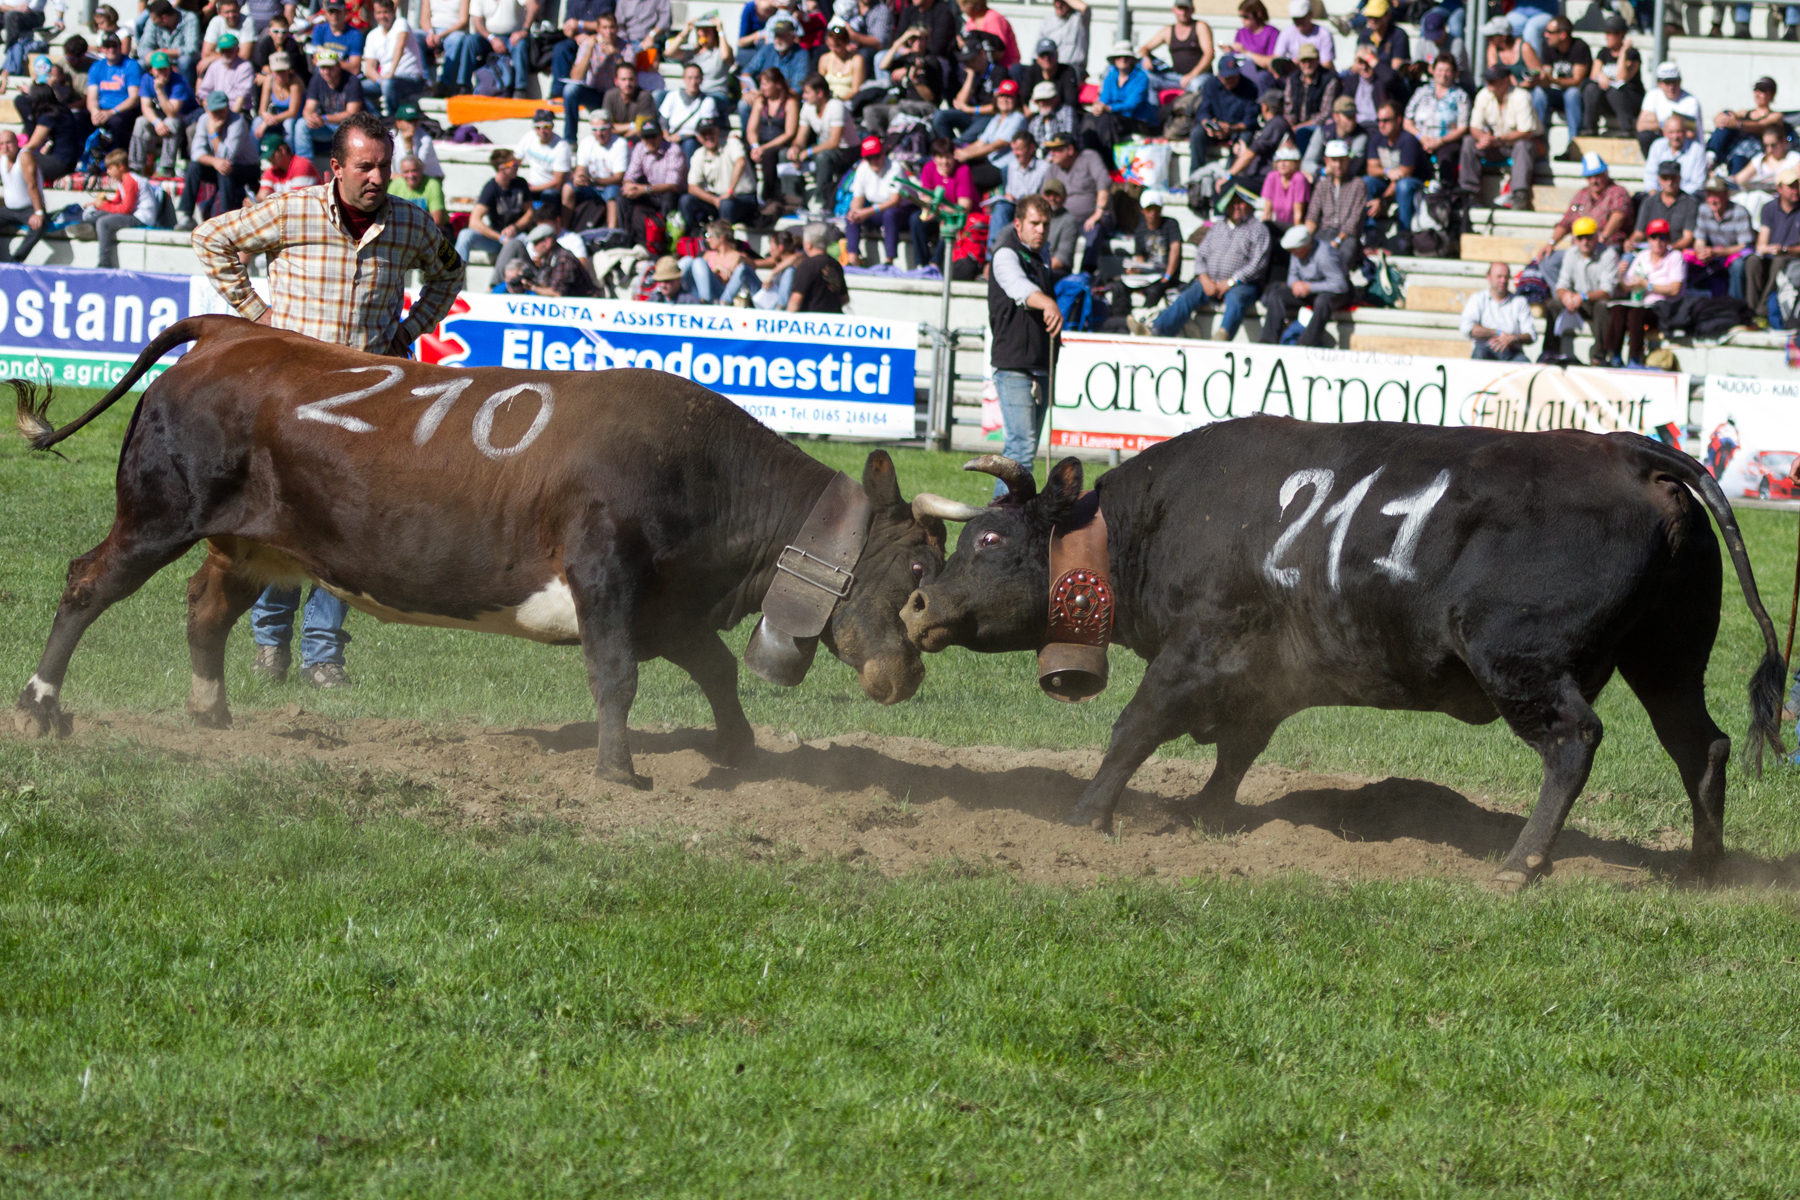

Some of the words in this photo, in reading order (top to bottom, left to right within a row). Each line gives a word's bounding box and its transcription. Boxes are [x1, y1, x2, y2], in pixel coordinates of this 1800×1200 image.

[507, 301, 592, 321] VENDITA
[613, 311, 733, 331] ASSISTENZA
[756, 319, 890, 339] RIPARAZIONI
[502, 329, 891, 395] Elettrodomestici
[1052, 349, 1191, 415] Lard
[1203, 352, 1447, 424] d'Arnad
[1717, 380, 1761, 395] NUOVO
[295, 365, 555, 460] 210
[791, 407, 808, 420] Tel.
[813, 409, 840, 422] 0165
[846, 411, 887, 425] 216164
[1081, 433, 1125, 449] Laurent
[1262, 463, 1450, 594] 211
